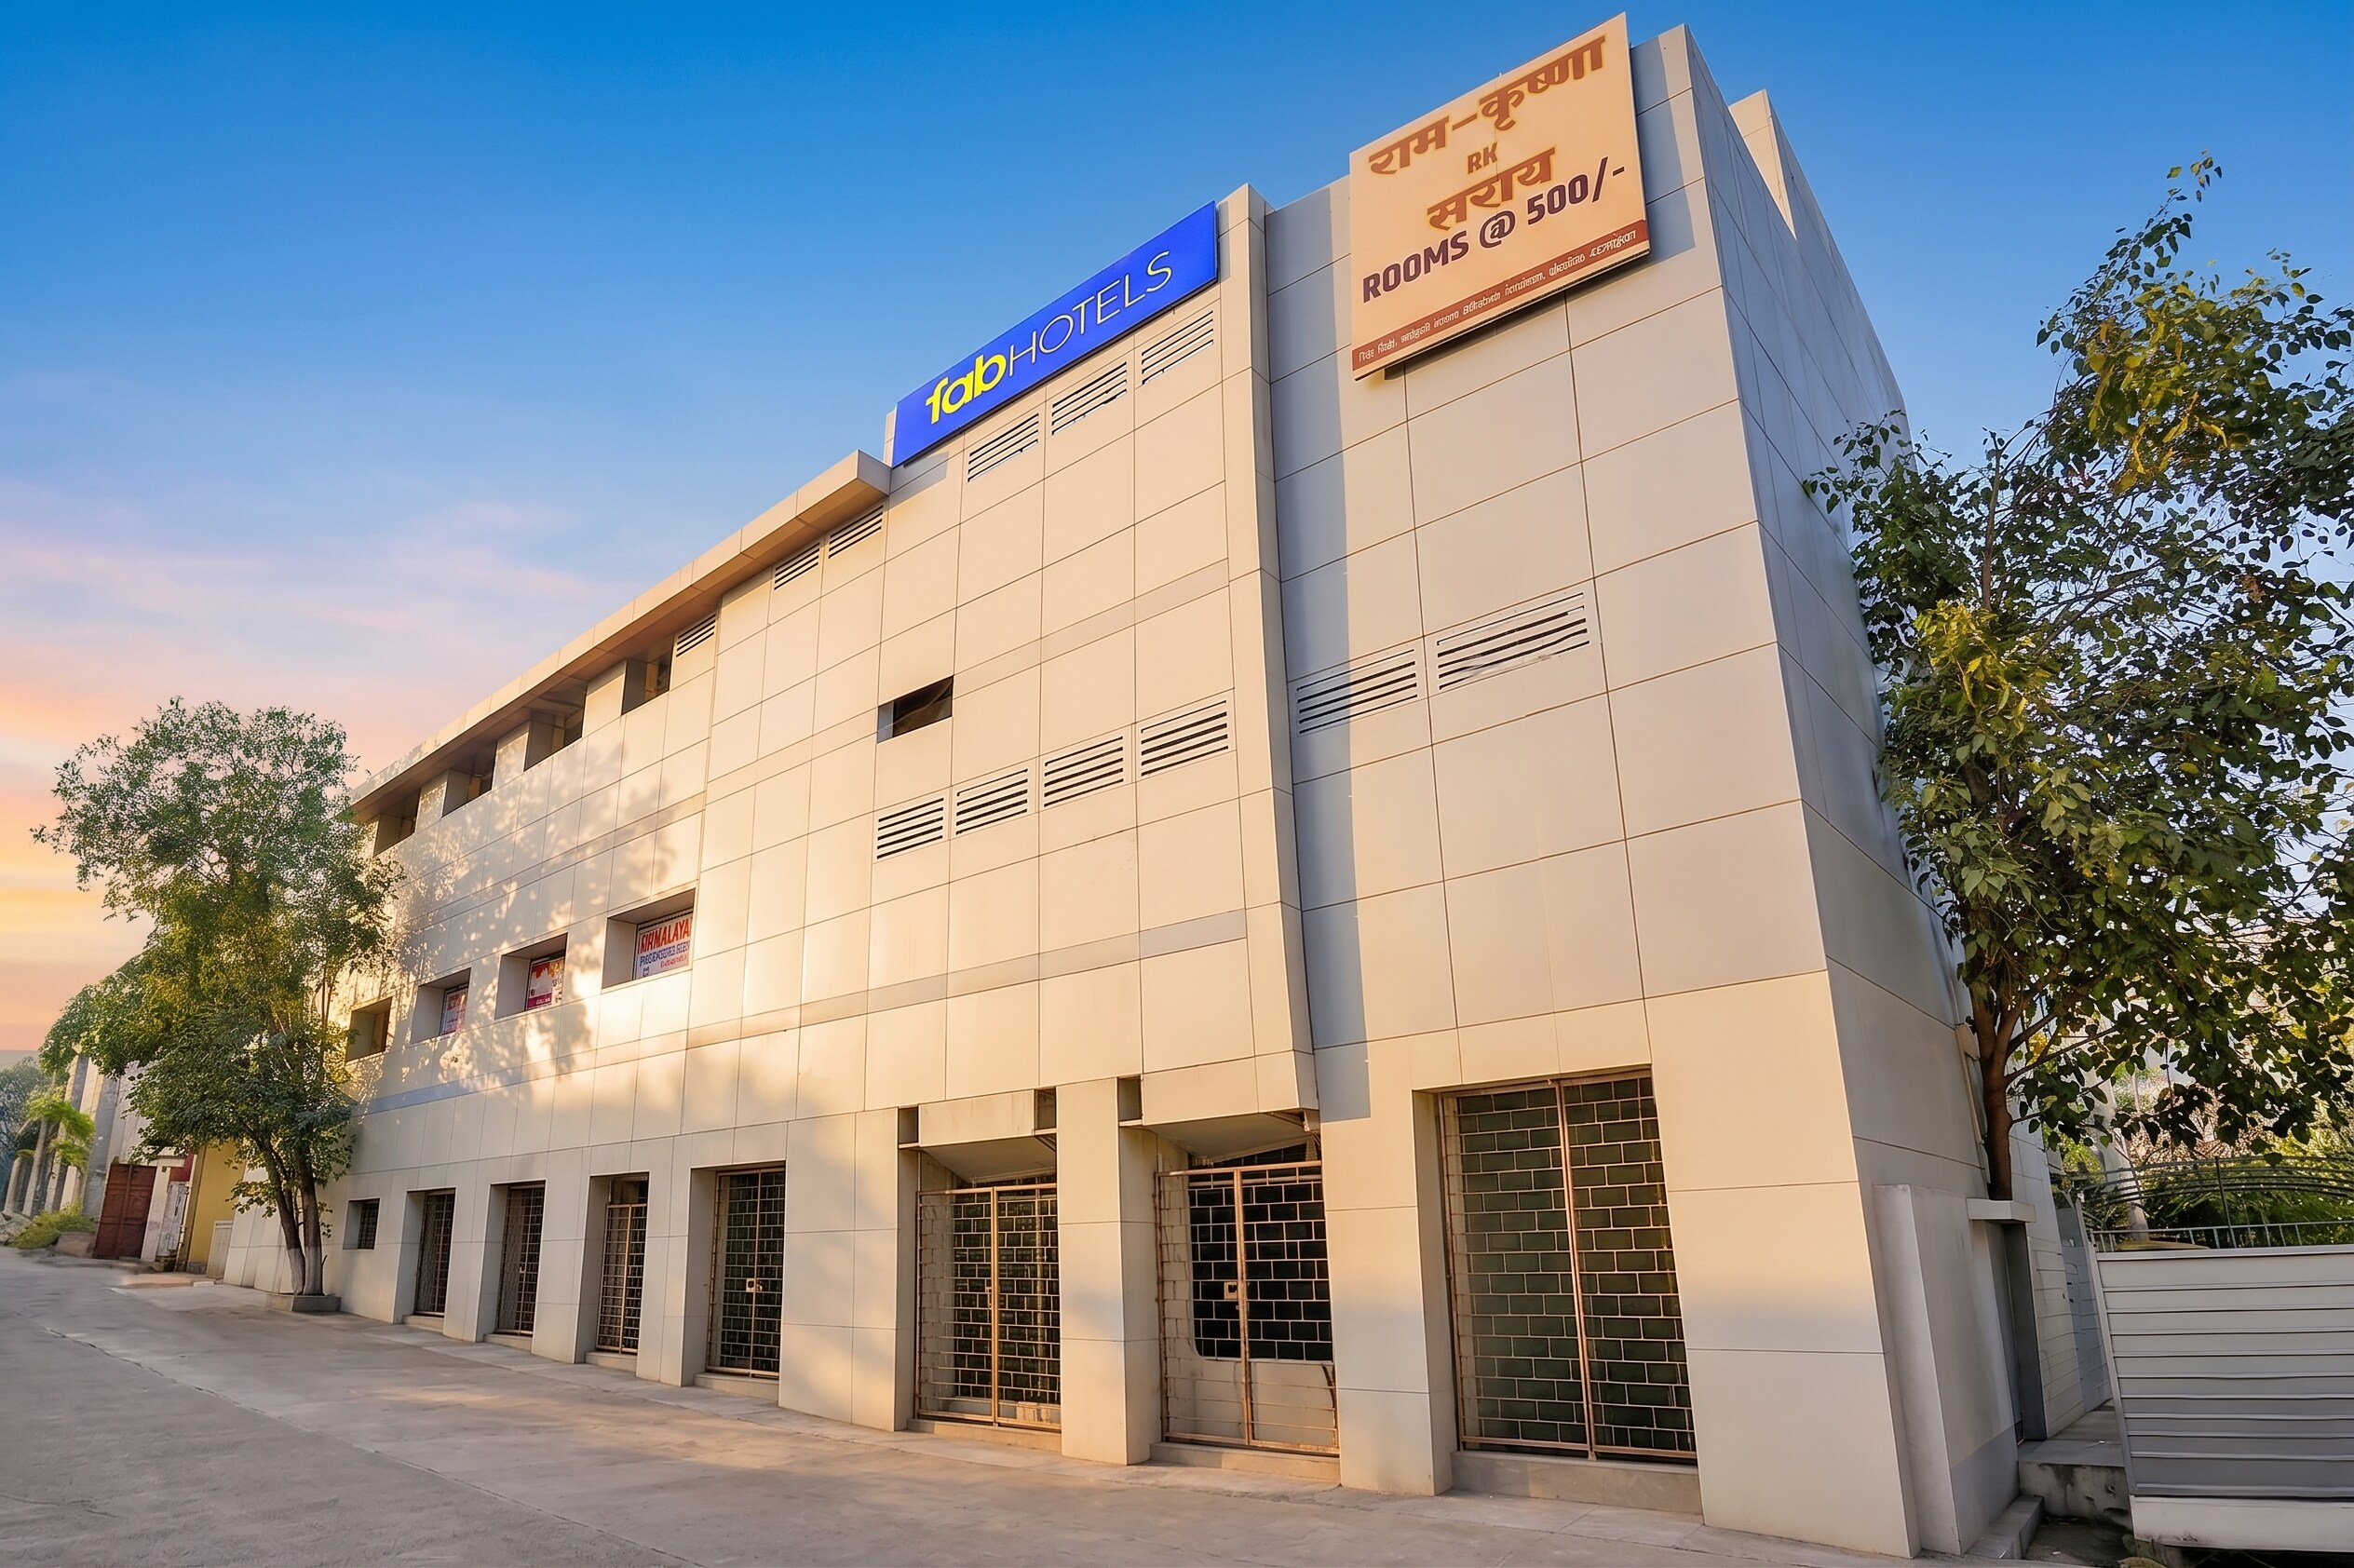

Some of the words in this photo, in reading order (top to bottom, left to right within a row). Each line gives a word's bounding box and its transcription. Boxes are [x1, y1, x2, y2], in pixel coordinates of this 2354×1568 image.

[1427, 146, 1556, 232] सराय
[1468, 142, 1498, 174] RK
[1362, 230, 1469, 304] ROOMS
[1479, 210, 1516, 249] @
[1526, 155, 1625, 226] 500/-
